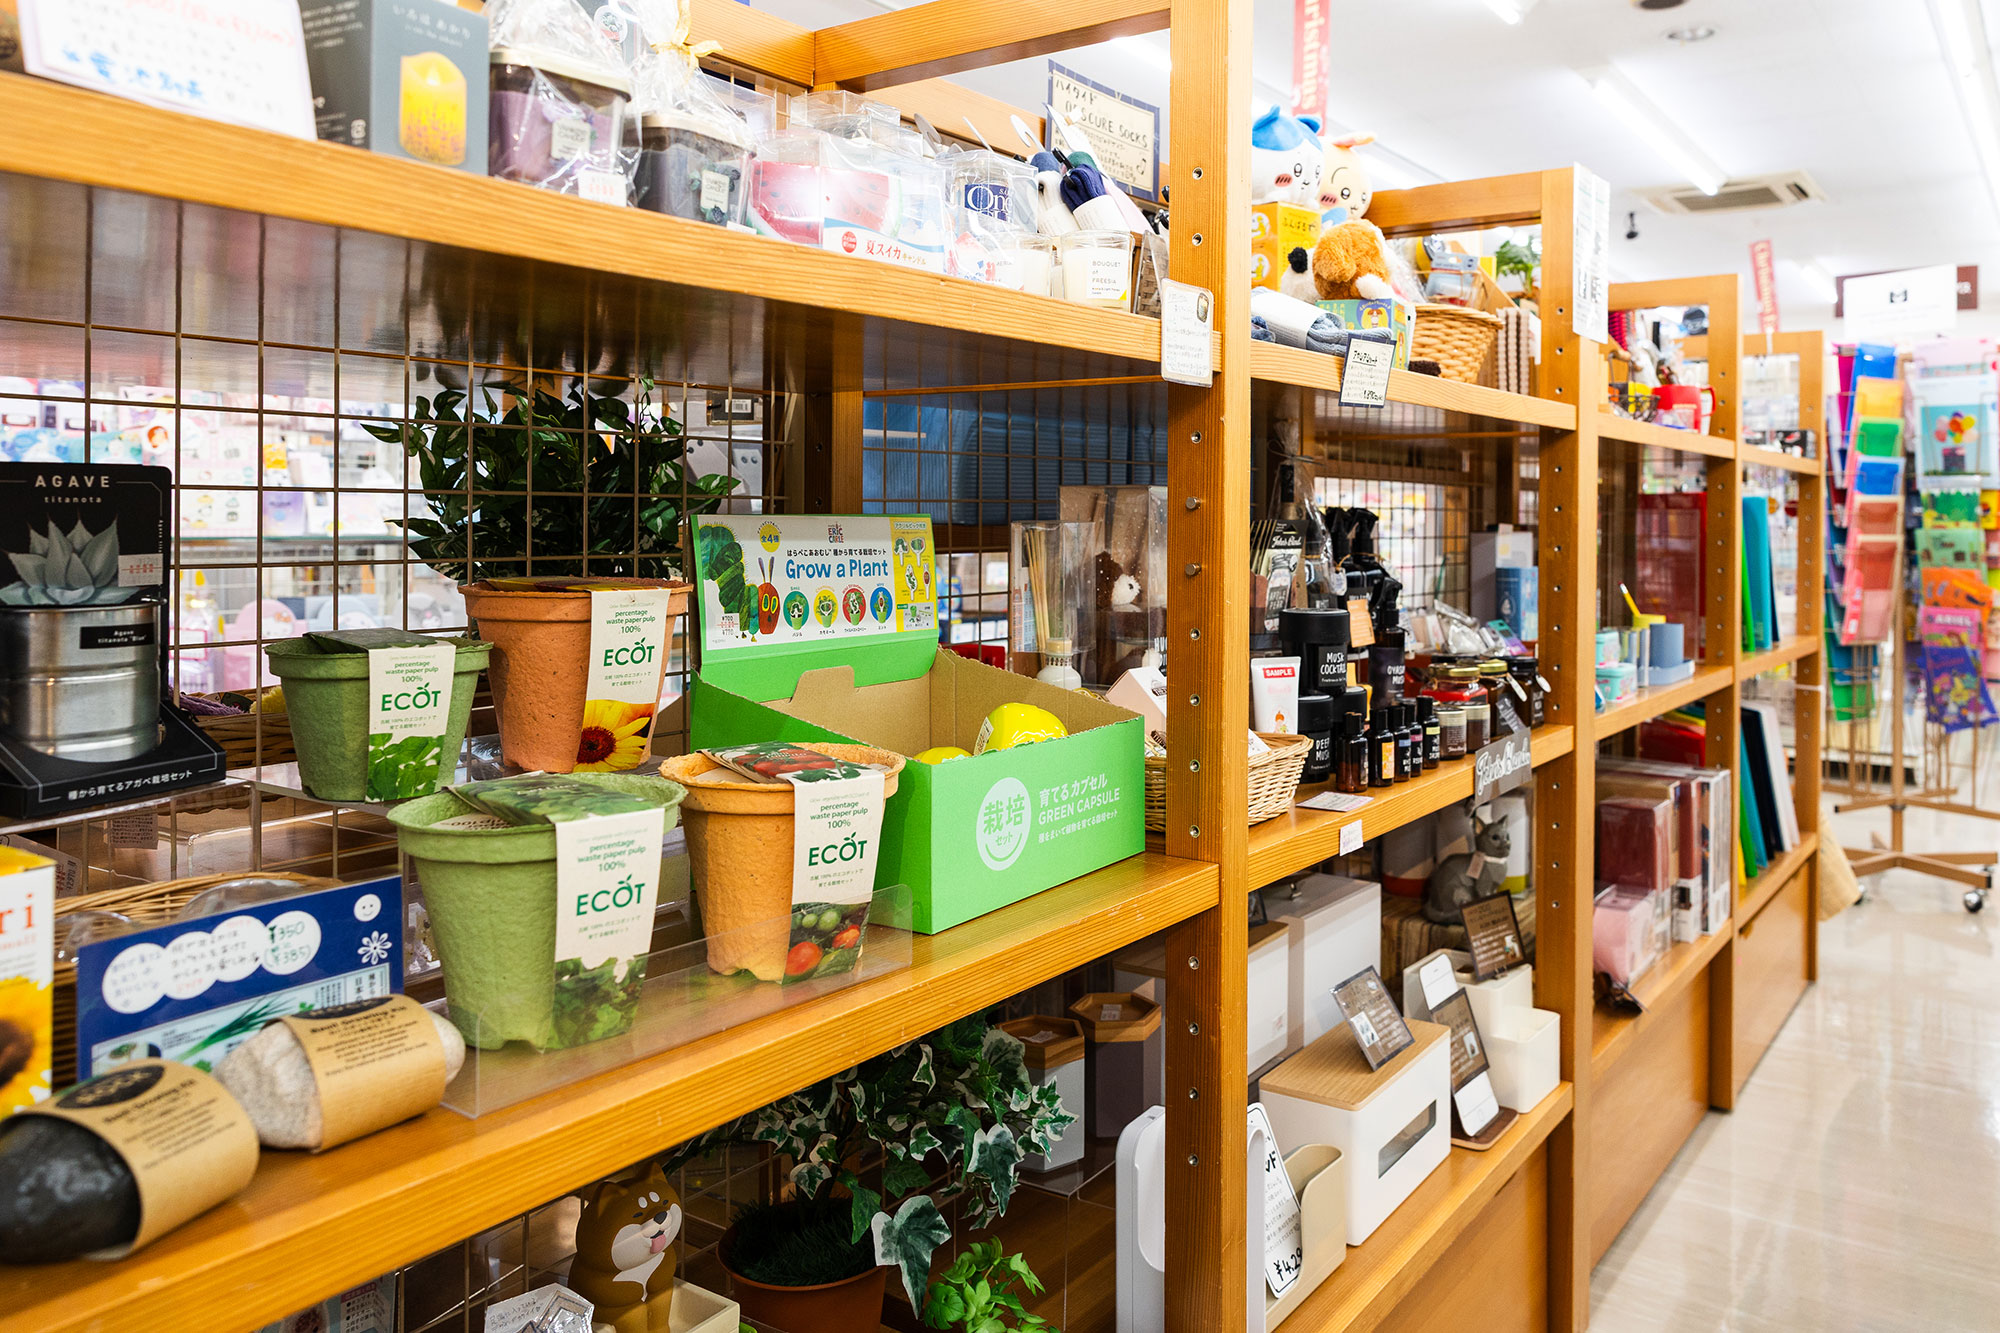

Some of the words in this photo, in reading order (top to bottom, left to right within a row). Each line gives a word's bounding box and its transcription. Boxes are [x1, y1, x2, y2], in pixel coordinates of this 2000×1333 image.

[1065, 100, 1114, 133] OSCURE
[1119, 124, 1148, 149] SOCKS
[865, 239, 901, 260] 夏スイカ
[35, 474, 110, 488] AGAVE
[44, 495, 103, 504] titanota
[785, 559, 831, 579] Grow
[836, 564, 845, 578] a
[849, 558, 888, 578] Plant
[615, 609, 648, 618] percentage
[624, 617, 642, 625] paper
[642, 615, 656, 623] pulp
[621, 625, 641, 634] 100%
[394, 661, 430, 669] percentage
[1326, 652, 1344, 664] MUSK
[405, 667, 423, 675] paper
[1265, 667, 1294, 678] SAMPLE
[401, 675, 423, 683] 100%
[68, 770, 193, 801] 種から育てるアガベ栽培セット
[1039, 773, 1108, 808] 育てるカプセル
[820, 801, 859, 812] percentage
[1038, 805, 1074, 825] GREEN
[1076, 787, 1121, 813] CAPSULE
[810, 812, 830, 821] waste
[831, 810, 852, 819] paper
[852, 807, 868, 817] pulp
[983, 793, 1025, 836] 栽培
[828, 819, 851, 829] 100%
[589, 838, 635, 853] percentage
[995, 831, 1013, 846] セット
[577, 853, 601, 863] waste
[602, 849, 627, 861] paper
[628, 845, 646, 856] pulp
[599, 860, 626, 872] 100%
[268, 921, 305, 944] ¥350
